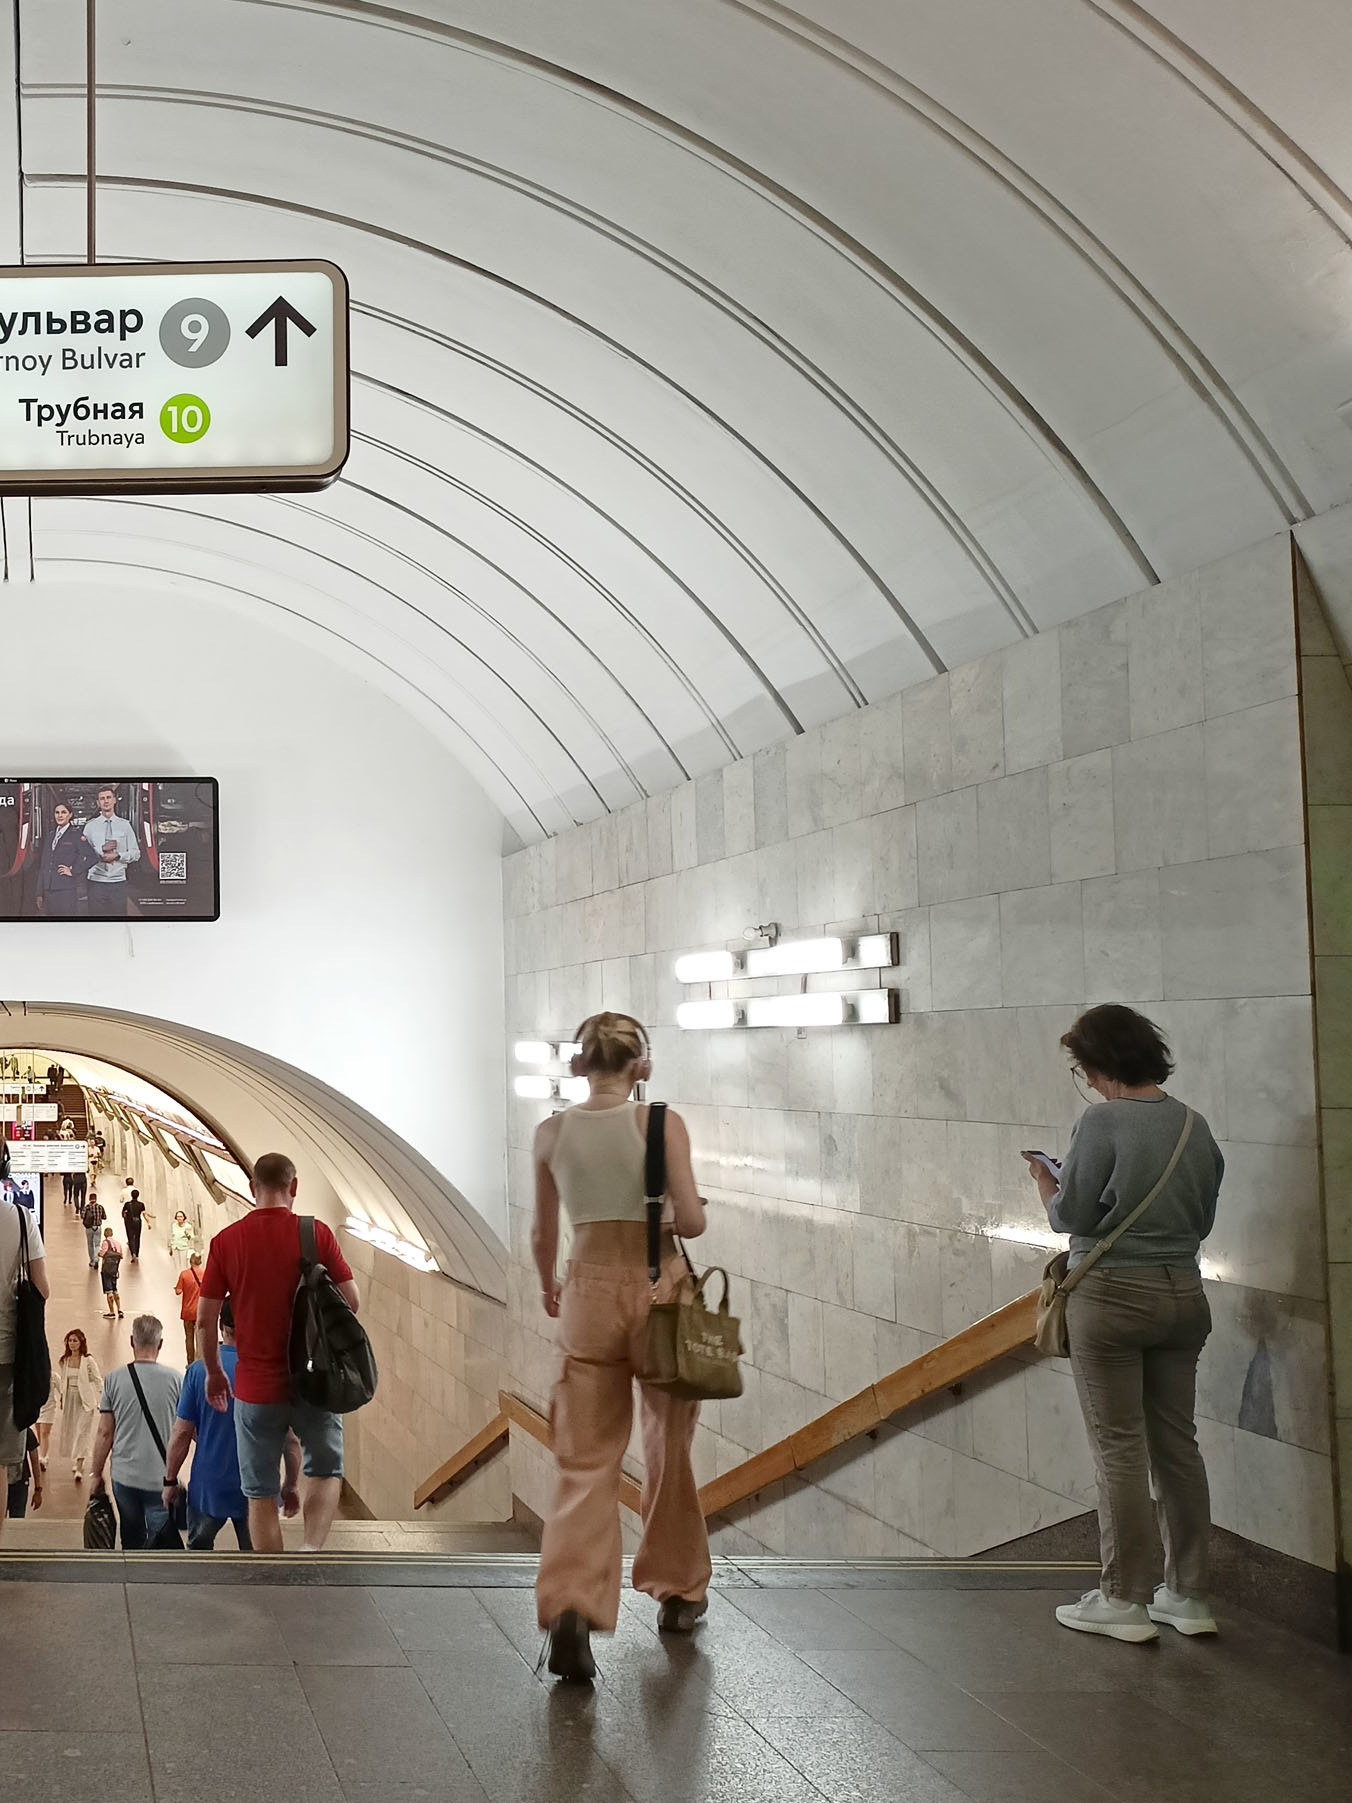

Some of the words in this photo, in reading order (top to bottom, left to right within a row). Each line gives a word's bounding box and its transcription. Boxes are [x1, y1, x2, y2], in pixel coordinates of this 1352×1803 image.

[179, 313, 209, 353] 9
[61, 346, 146, 371] Bulvar
[18, 396, 144, 427] Трубная
[166, 404, 203, 434] 10
[55, 429, 145, 448] Trubnaya
